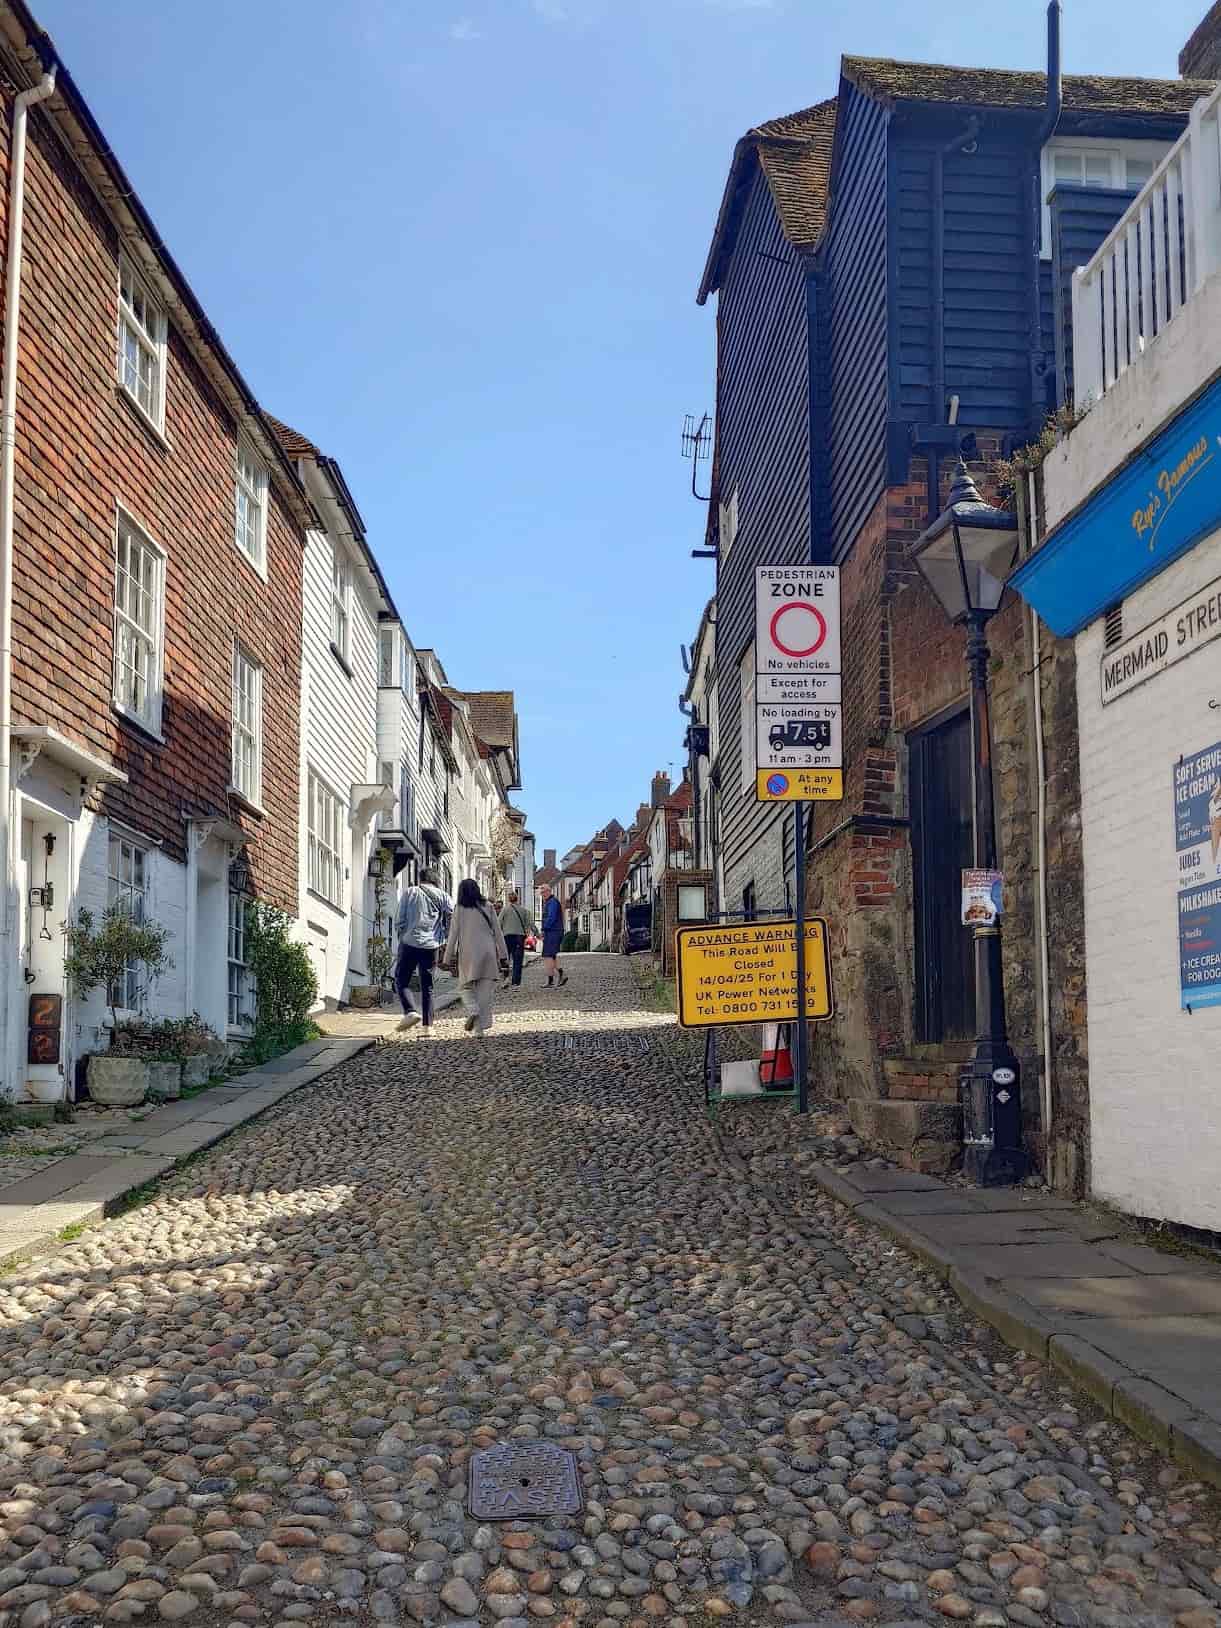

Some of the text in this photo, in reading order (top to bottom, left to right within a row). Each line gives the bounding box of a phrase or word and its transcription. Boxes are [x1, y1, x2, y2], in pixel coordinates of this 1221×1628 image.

[760, 570, 835, 579] PEDESTRIAN
[771, 583, 824, 597] ZONE
[768, 660, 830, 669] No vehicles
[1104, 631, 1168, 692] MERMAID
[771, 679, 828, 689] Except for
[781, 690, 817, 699] access
[762, 707, 837, 719] No loading by
[798, 774, 833, 784] At any
[1176, 762, 1194, 785] SOFT
[804, 786, 828, 794] time
[1176, 784, 1188, 805] ICE
[688, 932, 749, 945] ADVANCE
[703, 948, 725, 959] This
[729, 946, 759, 956] Road
[763, 942, 786, 953] Will
[734, 959, 774, 970] Closed
[700, 973, 754, 985] 14/04/25
[759, 972, 776, 982] For
[791, 970, 812, 981] Dy
[696, 985, 817, 1001] UK Power Netwoks
[723, 1002, 758, 1014] 0800
[762, 1000, 781, 1011] 731
[785, 998, 815, 1010] 159
